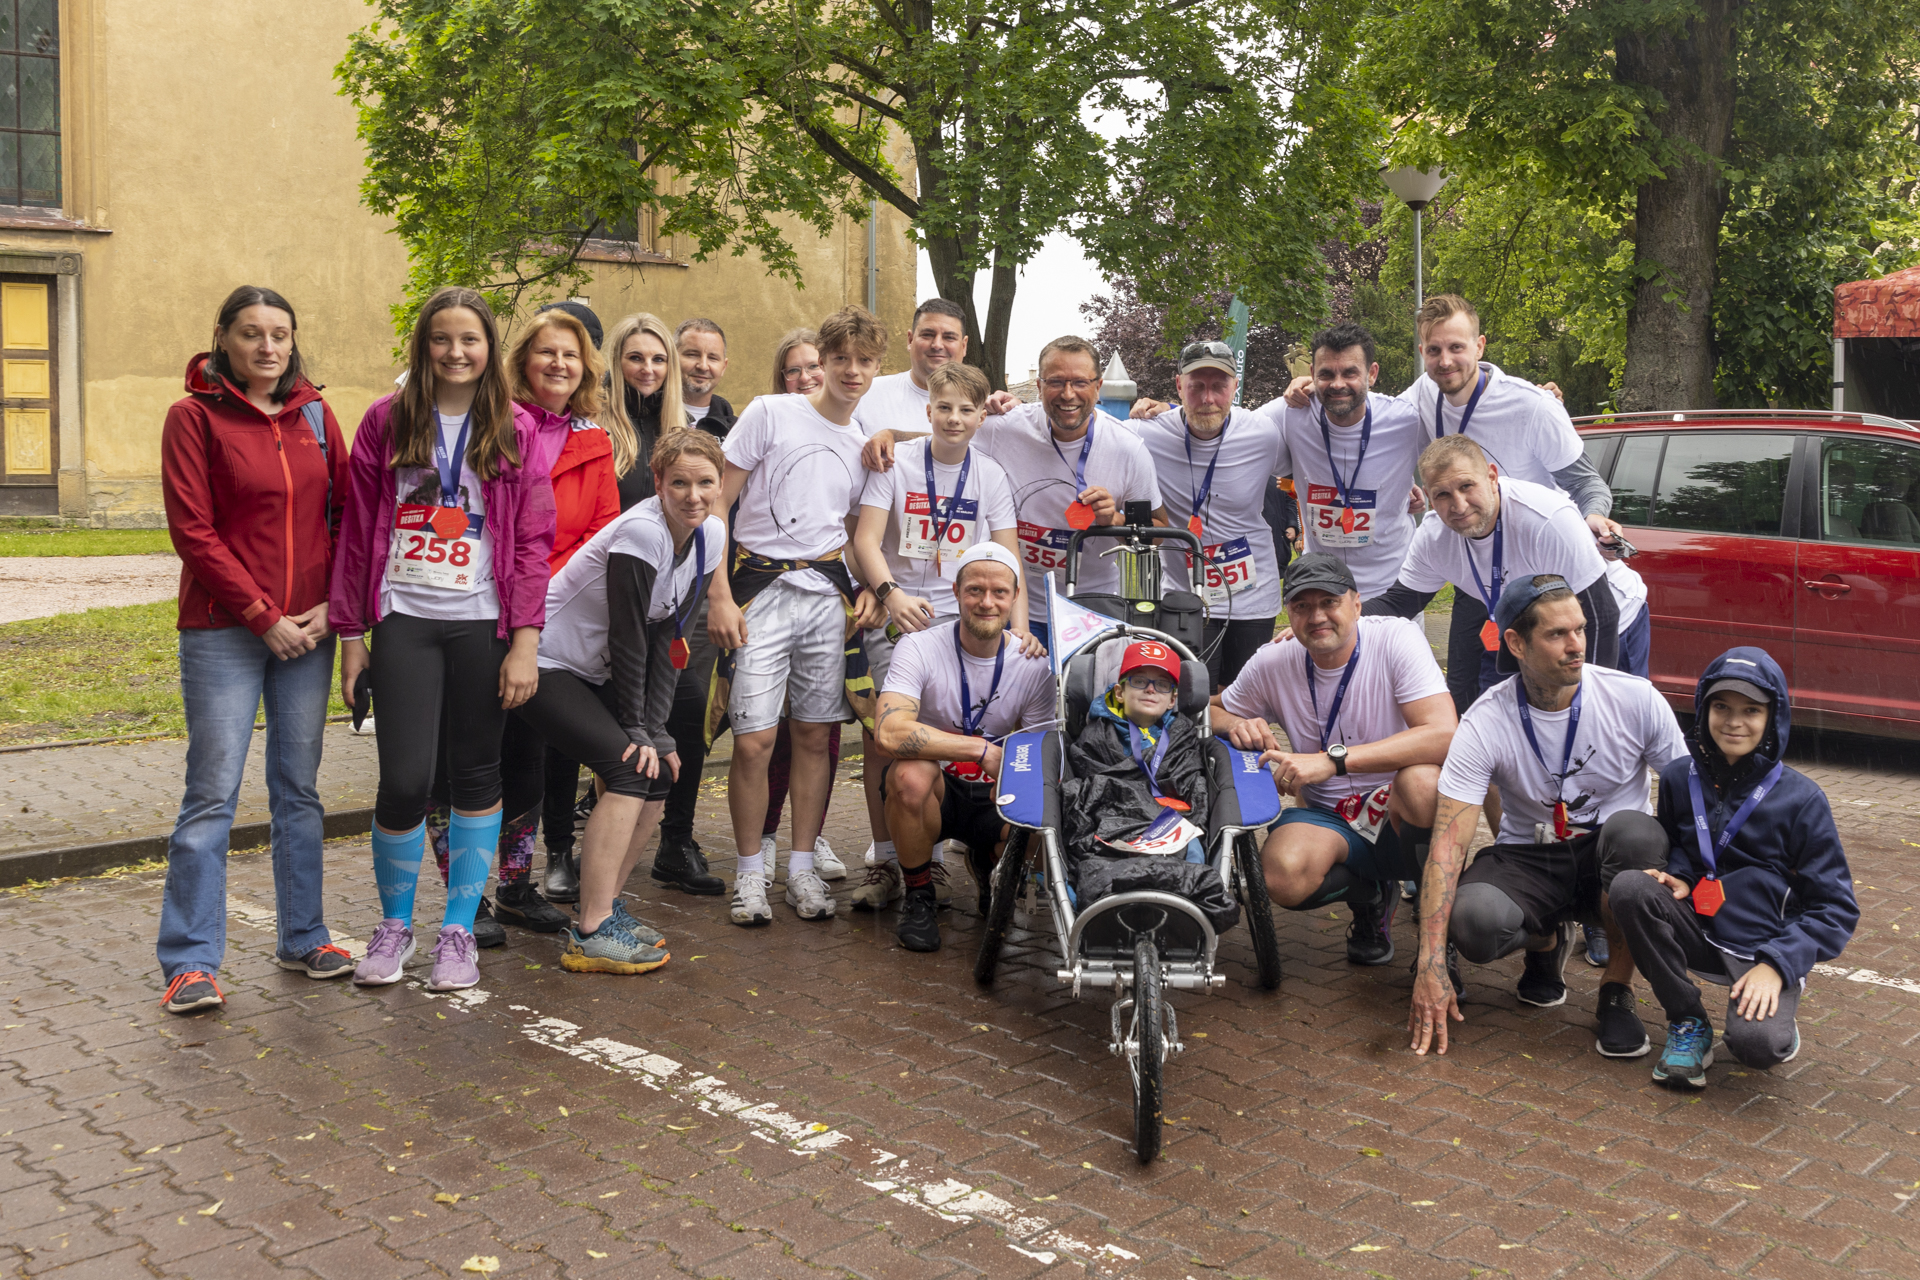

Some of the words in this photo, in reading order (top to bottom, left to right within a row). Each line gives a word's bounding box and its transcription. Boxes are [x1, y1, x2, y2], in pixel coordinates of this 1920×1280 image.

[1231, 349, 1245, 408] EX-auto
[403, 534, 472, 567] 258
[1205, 561, 1249, 588] 551
